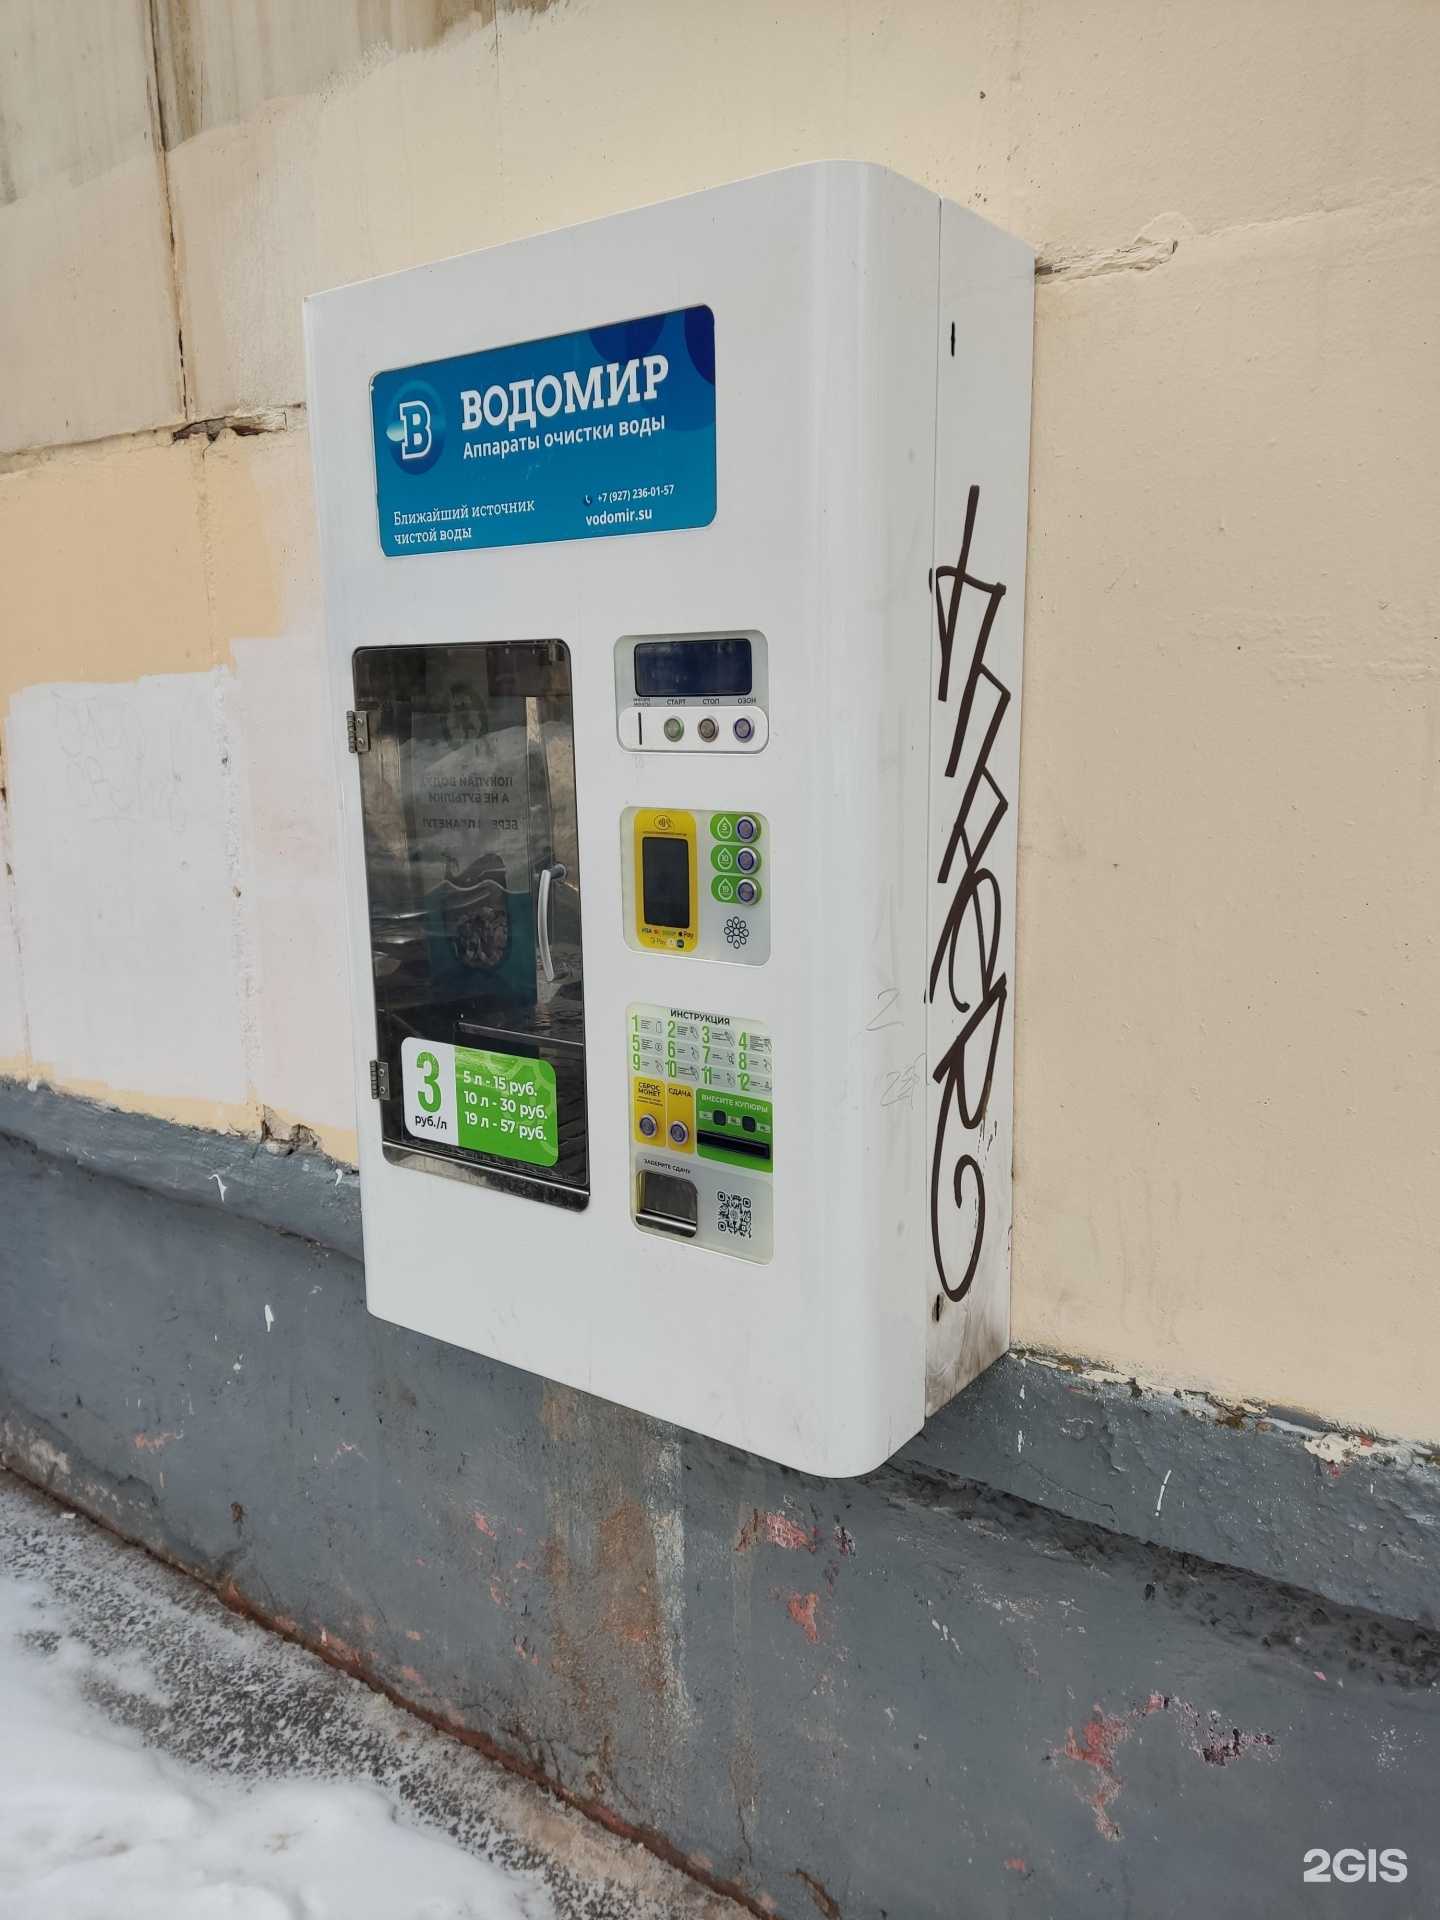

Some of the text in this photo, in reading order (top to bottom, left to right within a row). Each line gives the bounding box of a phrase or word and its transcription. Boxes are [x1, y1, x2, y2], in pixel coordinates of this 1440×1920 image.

[460, 355, 669, 432] ВОДОМИР
[464, 415, 665, 460] Аппараты очистки воды
[597, 484, 675, 504] +7 (927) 236-01-57
[393, 499, 535, 526] Ближайший источник
[585, 507, 653, 527] vodomir.su
[394, 527, 472, 545] чистой воды
[632, 1015, 638, 1032] 1
[670, 1009, 730, 1025] ИНСТРУКЦИЯ
[667, 1020, 676, 1038] 2
[702, 1025, 710, 1044] 3
[633, 1034, 640, 1052] 5
[668, 1040, 675, 1058] 6
[738, 1032, 747, 1051] 4
[633, 1054, 640, 1071] 9
[702, 1046, 710, 1063] 7
[738, 1052, 747, 1070] 8
[665, 1059, 677, 1078] 10
[701, 1066, 712, 1085] 11
[416, 1051, 442, 1113] 3
[463, 1070, 471, 1084] 5
[473, 1074, 482, 1085] л
[493, 1076, 507, 1090] 15
[510, 1082, 538, 1096] руб.
[639, 1081, 660, 1092] СБРОС
[737, 1072, 750, 1092] 12
[639, 1087, 661, 1097] МОНЕТ
[668, 1086, 692, 1098] СДАЧА
[463, 1090, 477, 1105] 10
[480, 1096, 489, 1107] л
[500, 1097, 516, 1113] 30
[520, 1103, 548, 1120] руб.
[701, 1093, 768, 1113] ВНЕСИТЕ КУПЮРЫ
[415, 1113, 448, 1130] руб./л
[464, 1111, 477, 1125] 19
[480, 1116, 489, 1128] л
[500, 1119, 516, 1134] 57
[519, 1124, 547, 1141] руб.
